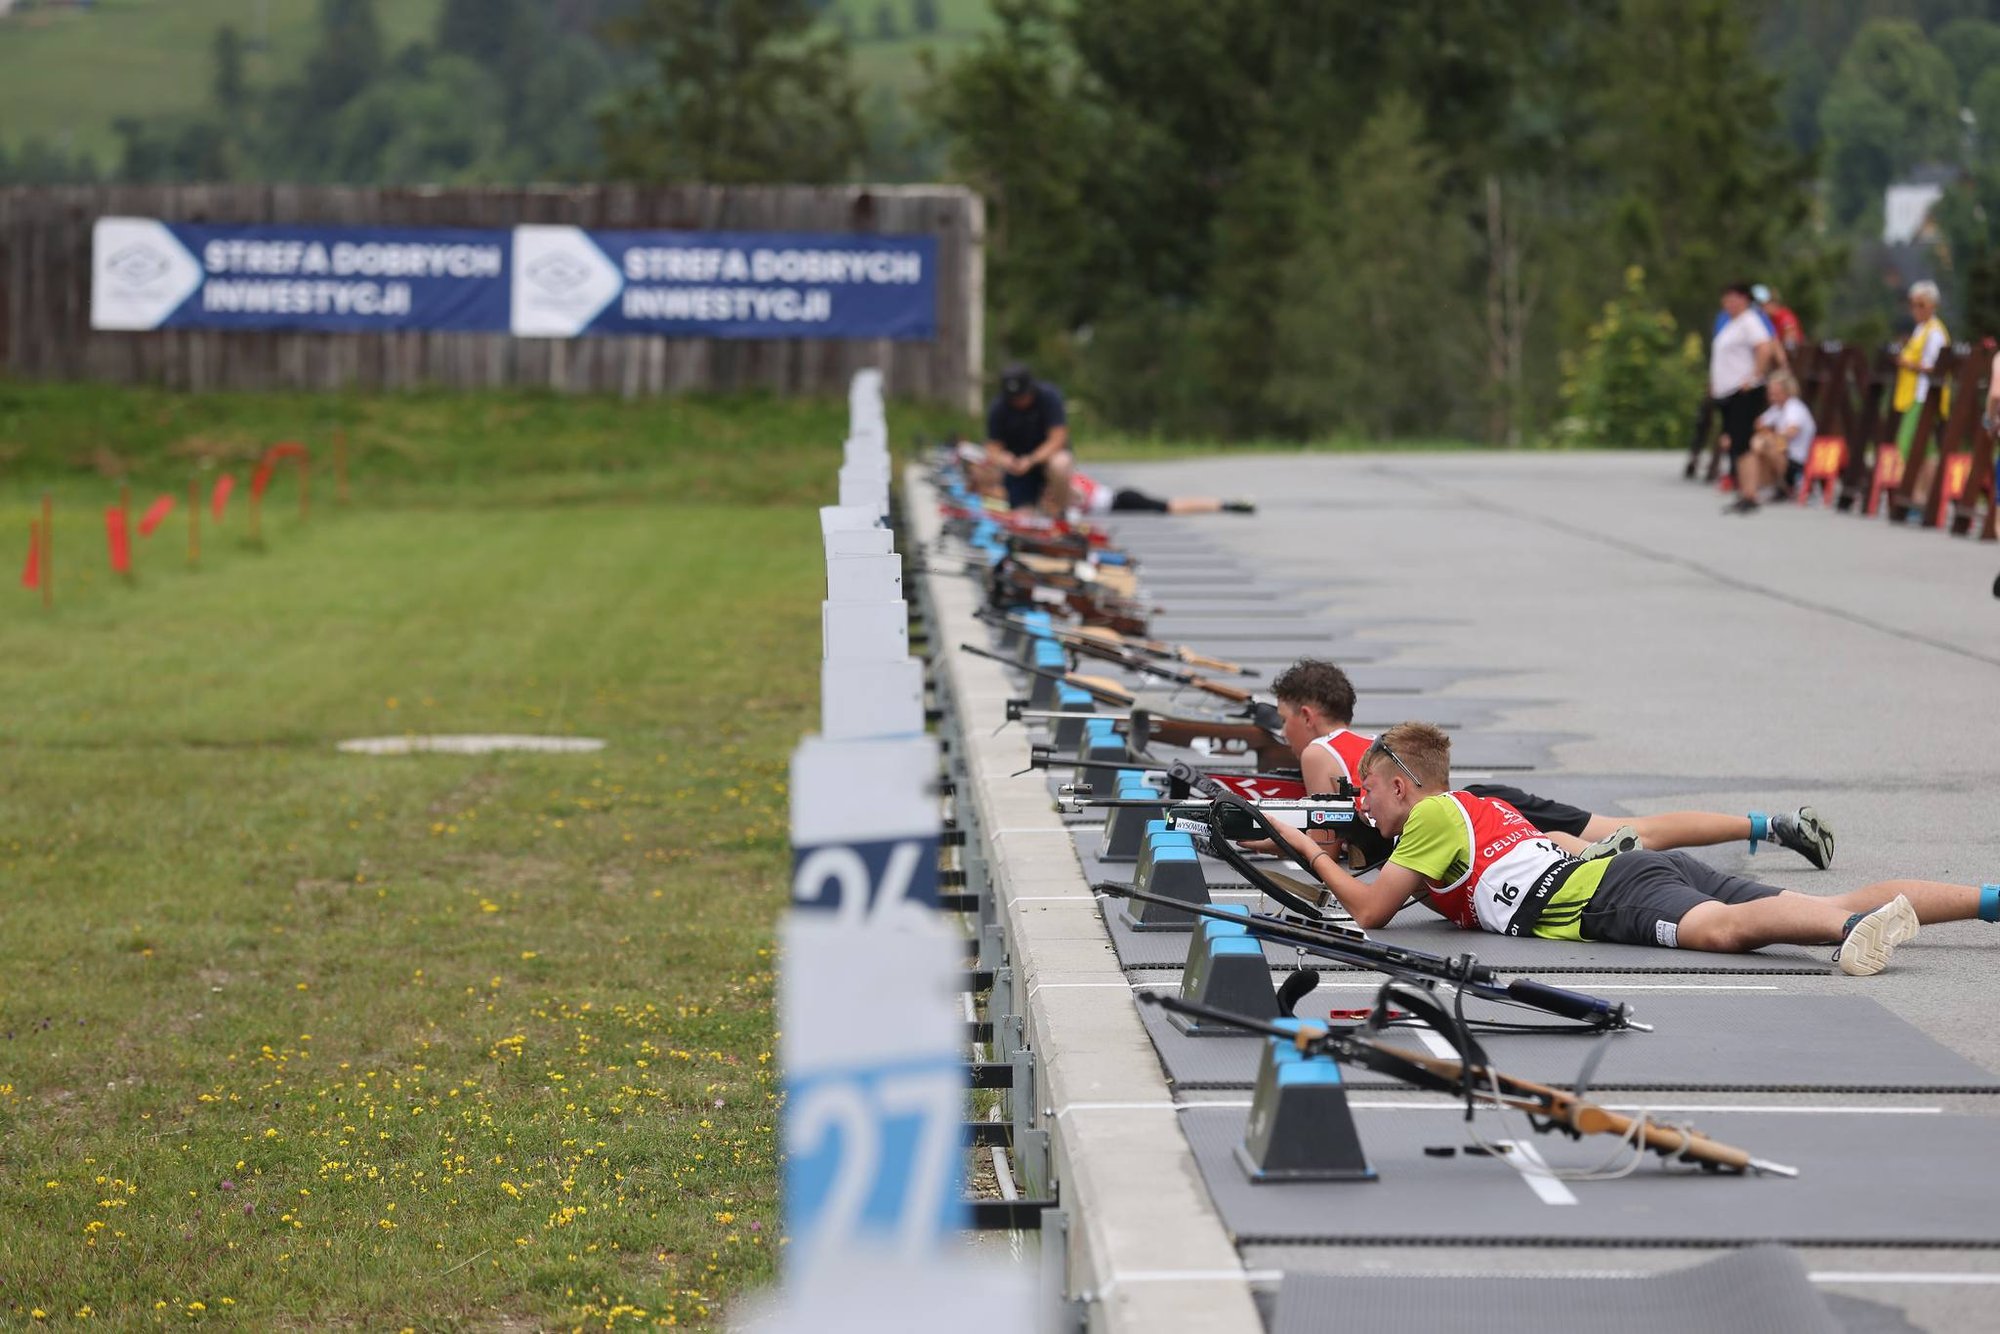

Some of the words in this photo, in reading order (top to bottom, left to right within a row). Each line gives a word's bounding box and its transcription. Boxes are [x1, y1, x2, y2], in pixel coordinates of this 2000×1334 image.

[203, 239, 330, 273] STREFA
[332, 243, 501, 277] DOBRYCH
[622, 248, 749, 281] STREFA
[750, 251, 921, 284] DOBRYCH
[203, 279, 412, 315] INWESTYCJI
[621, 287, 831, 322] INWESTYCJI
[1325, 813, 1351, 821] LAPUA
[1493, 882, 1520, 907] 16
[789, 1069, 962, 1254] 27
